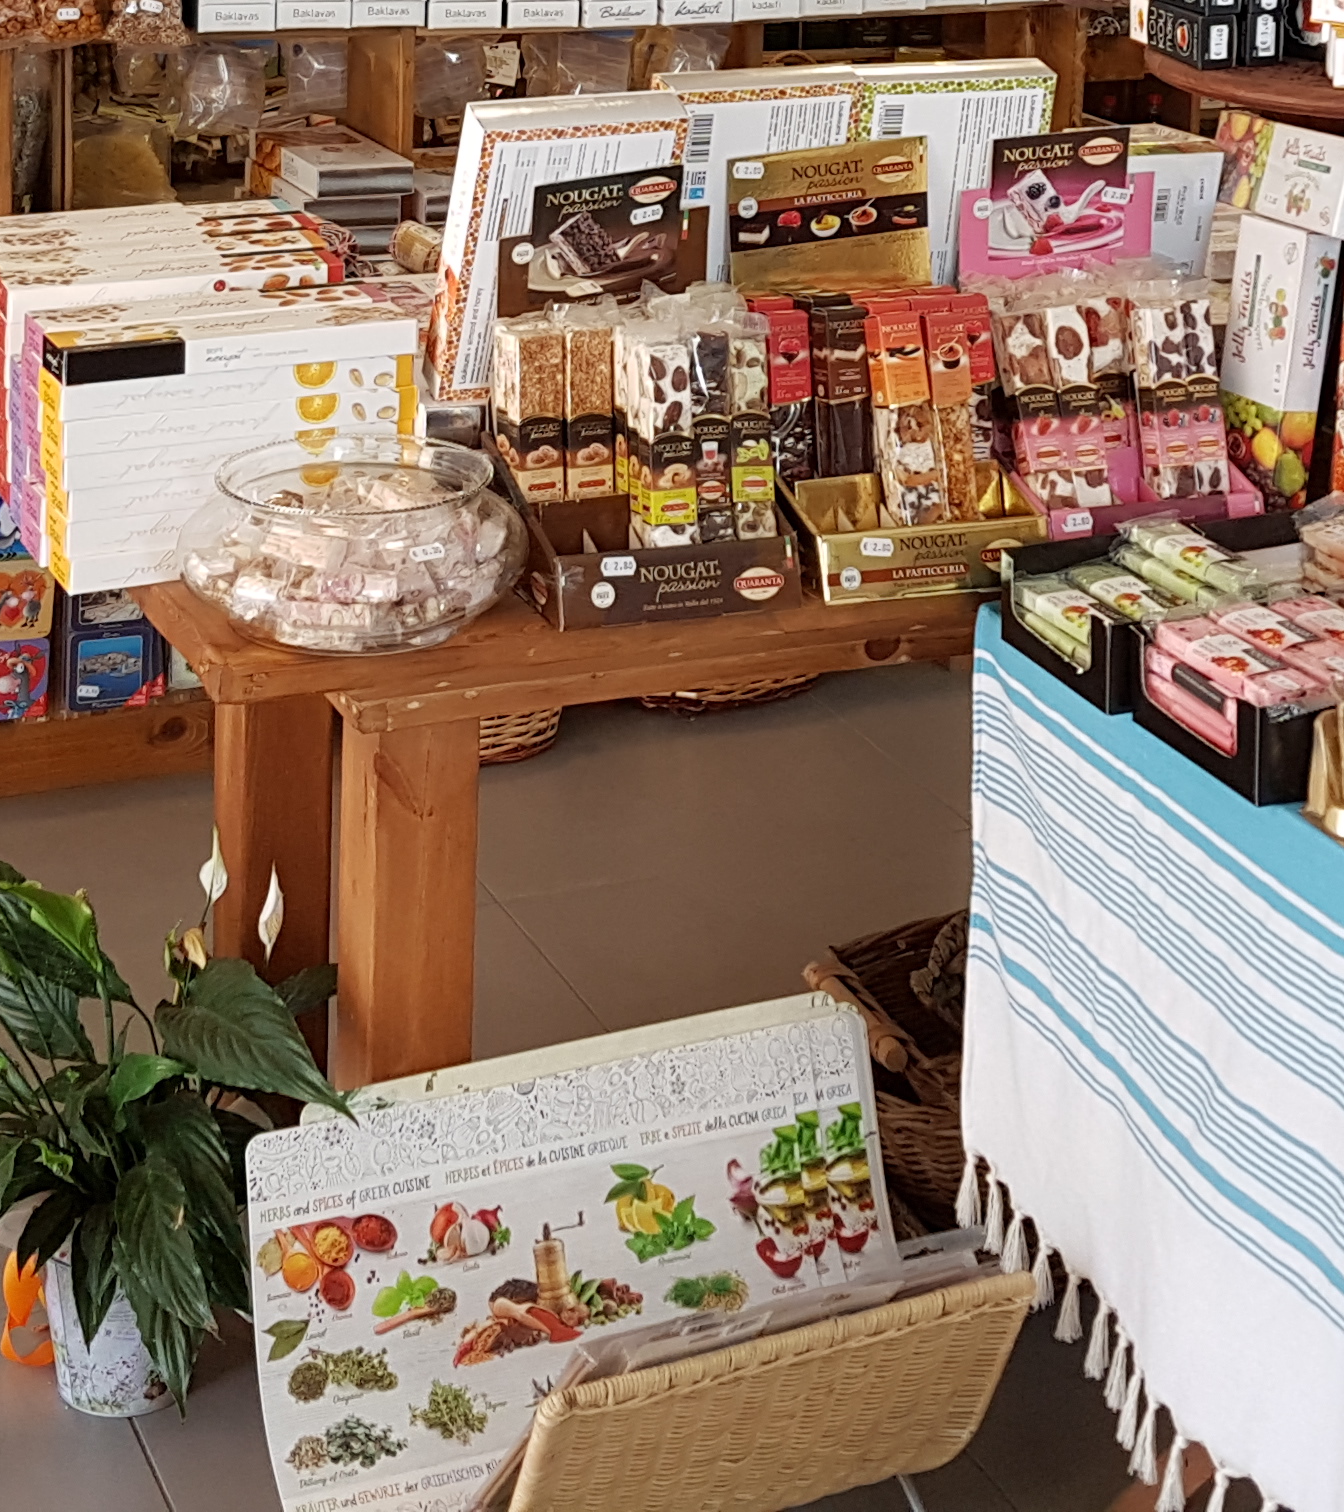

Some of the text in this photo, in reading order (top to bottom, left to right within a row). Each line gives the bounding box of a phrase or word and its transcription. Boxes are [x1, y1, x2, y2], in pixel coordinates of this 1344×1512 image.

[367, 6, 410, 18] Baklavas
[523, 8, 564, 19] Baklavas
[751, 0, 781, 11] kadaifi
[1002, 142, 1074, 164] NOUGAT
[1079, 145, 1123, 157] QUARANTA
[743, 166, 762, 176] 2.80
[791, 160, 863, 182] NOUGAT
[873, 164, 914, 174] QUARANTA
[1014, 157, 1073, 178] passion
[630, 182, 677, 196] QUARANTA
[805, 175, 863, 195] passion
[546, 183, 622, 207] NOUGAT
[793, 190, 863, 206] LA PASTICCERIA
[558, 198, 622, 222] passion
[642, 208, 661, 220] 2.80
[1231, 325, 1253, 363] Jelly
[872, 542, 891, 552] 2.80
[899, 533, 968, 551] NOUGAT
[613, 560, 633, 572] 2.80
[639, 560, 722, 584] NOUGAT
[892, 563, 966, 579] LA PASTICCERIA
[655, 578, 721, 603] passion
[736, 576, 783, 589] QUARANTA
[826, 1083, 852, 1100] GRECA
[639, 1129, 663, 1146] ERBE
[664, 1132, 670, 1140] e
[704, 1115, 727, 1133] della
[728, 1110, 760, 1128] CUCINA
[761, 1105, 788, 1123] GRECA
[445, 1135, 629, 1186] HERBES et ÉPICES de la CUISINE GRECQUE
[259, 1175, 432, 1224] HERBS and SPICES of GREEK CUISINE
[340, 1493, 357, 1508] und
[404, 1481, 419, 1494] der
[421, 1466, 485, 1491] GRIECHISCHEN
